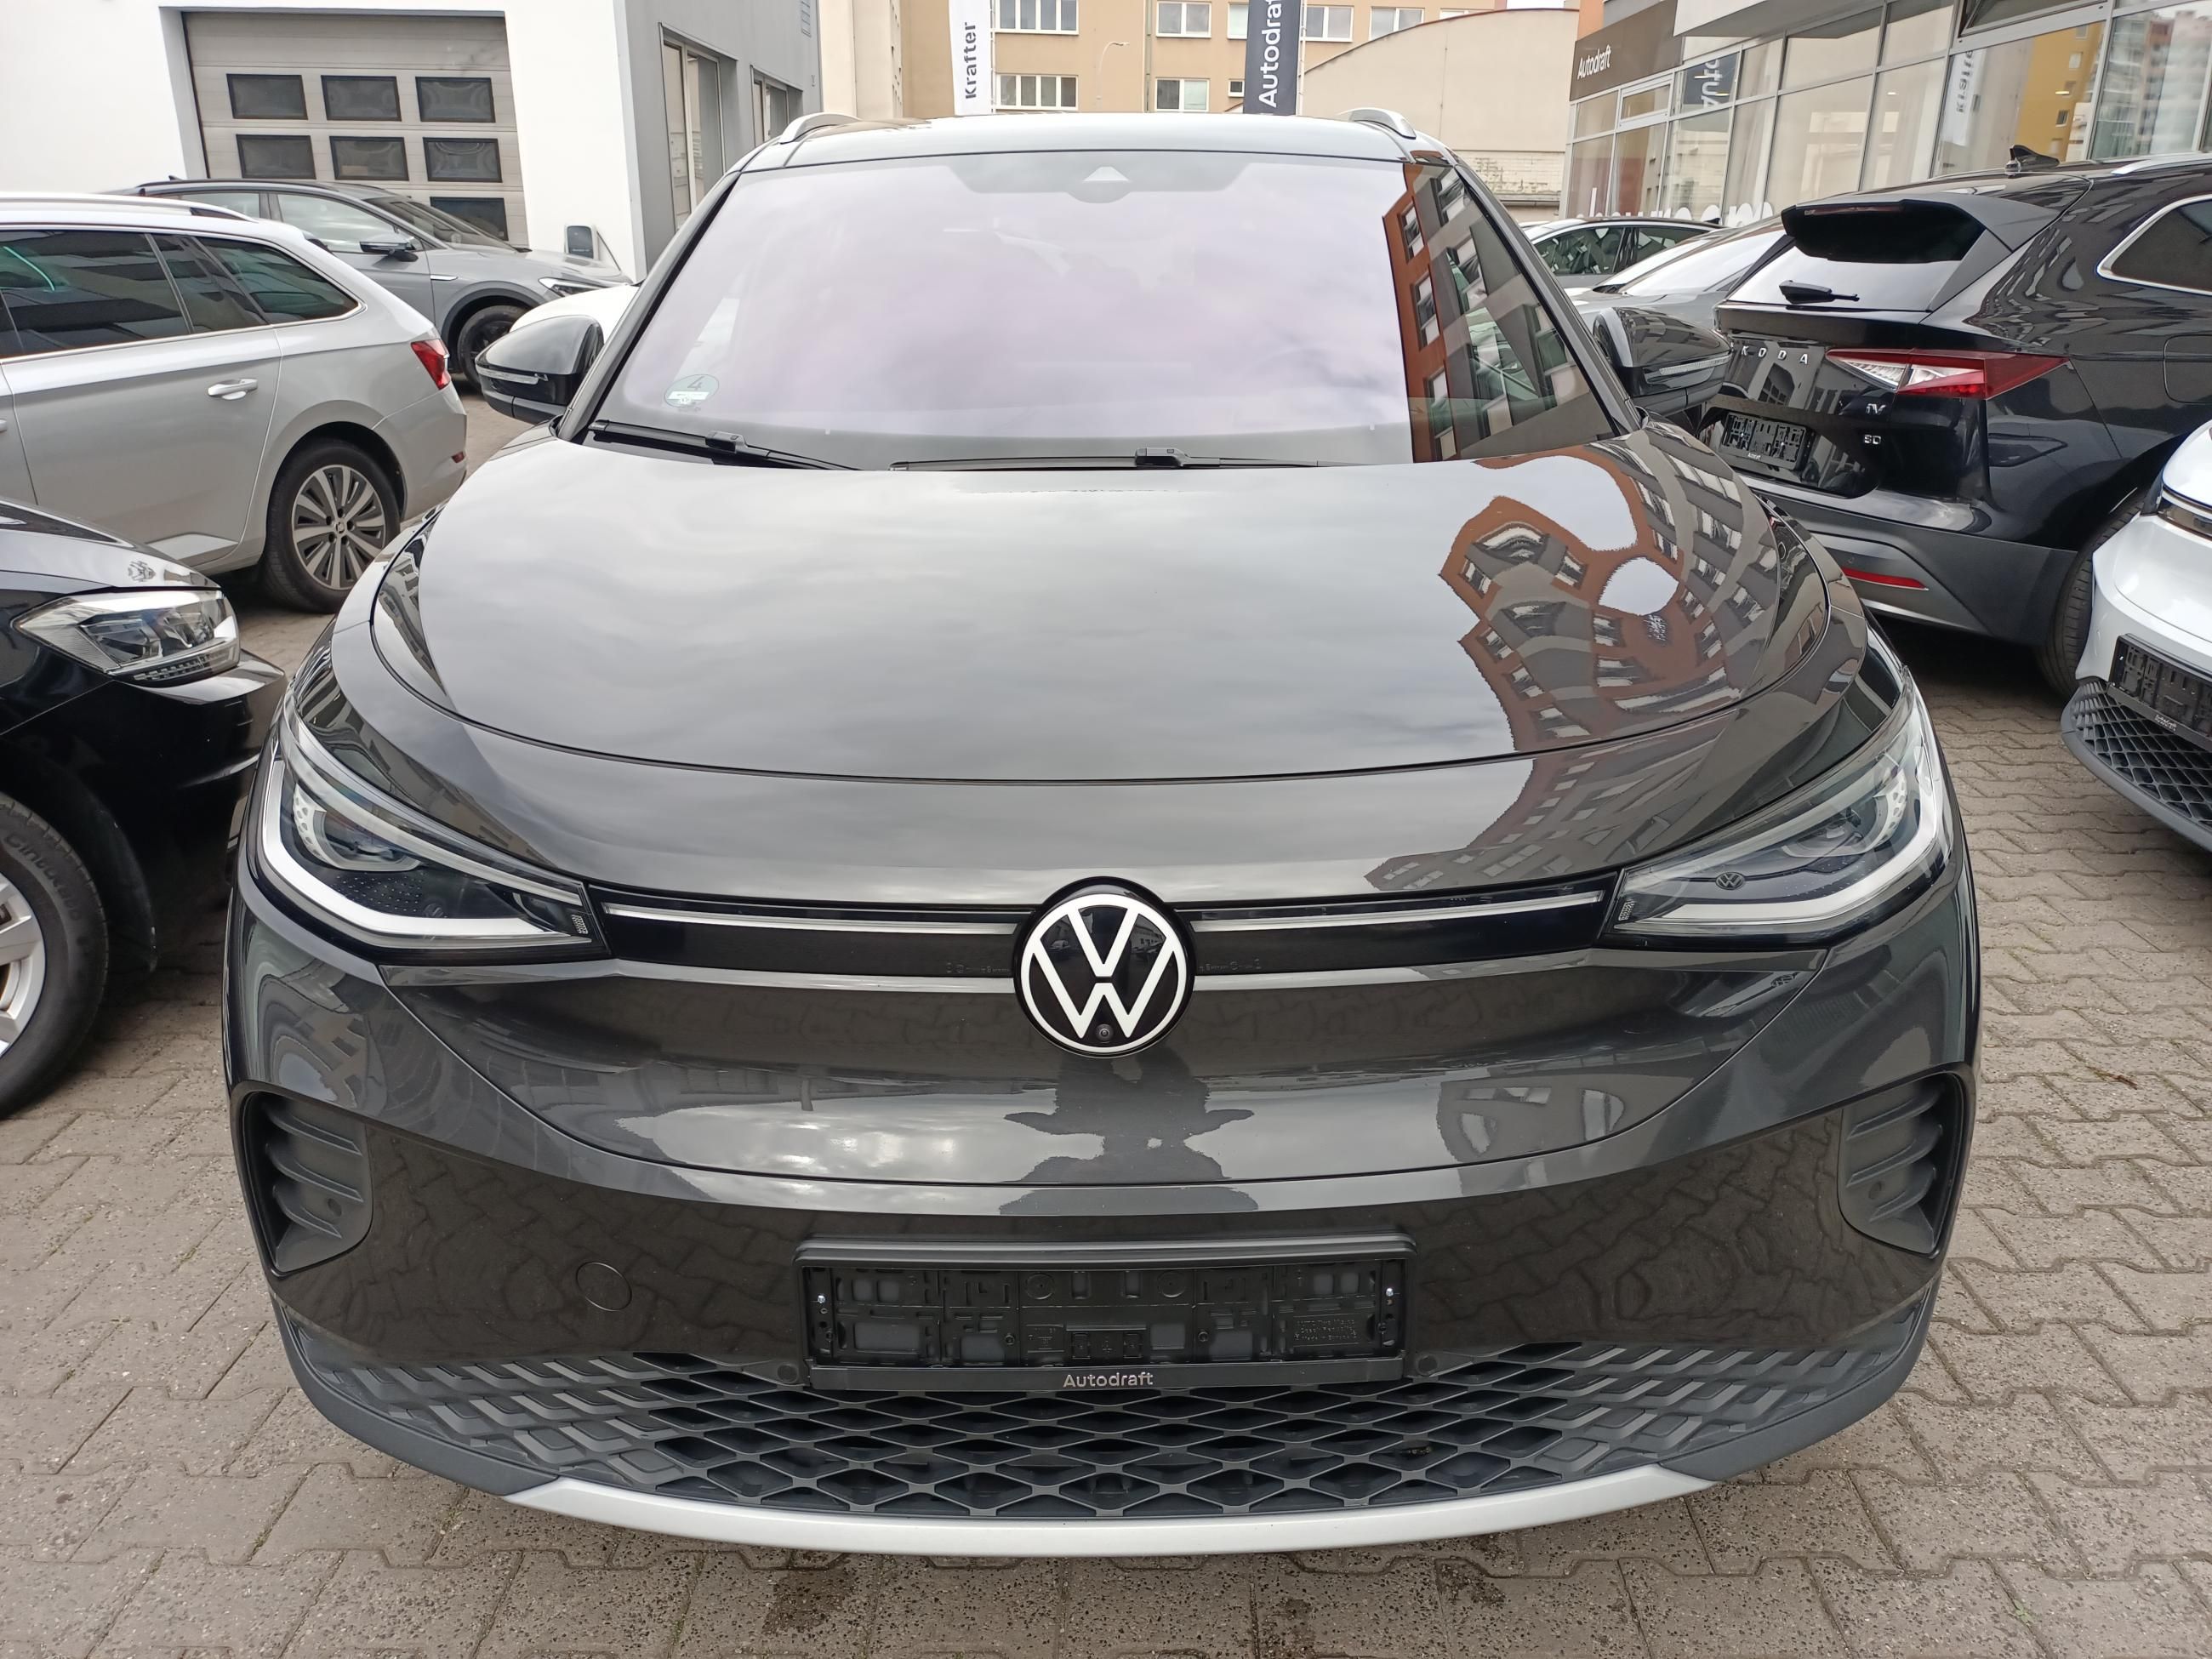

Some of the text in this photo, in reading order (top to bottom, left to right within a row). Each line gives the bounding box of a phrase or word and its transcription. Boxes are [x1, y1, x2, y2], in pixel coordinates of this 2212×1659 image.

[964, 21, 977, 100] Krafter
[1259, 0, 1282, 108] Autodra
[1576, 43, 1612, 81] Autodraft
[1730, 341, 1809, 365] KODA
[687, 375, 705, 391] 4
[1026, 898, 1182, 1043] VW
[1063, 1371, 1154, 1388] Autodraft
